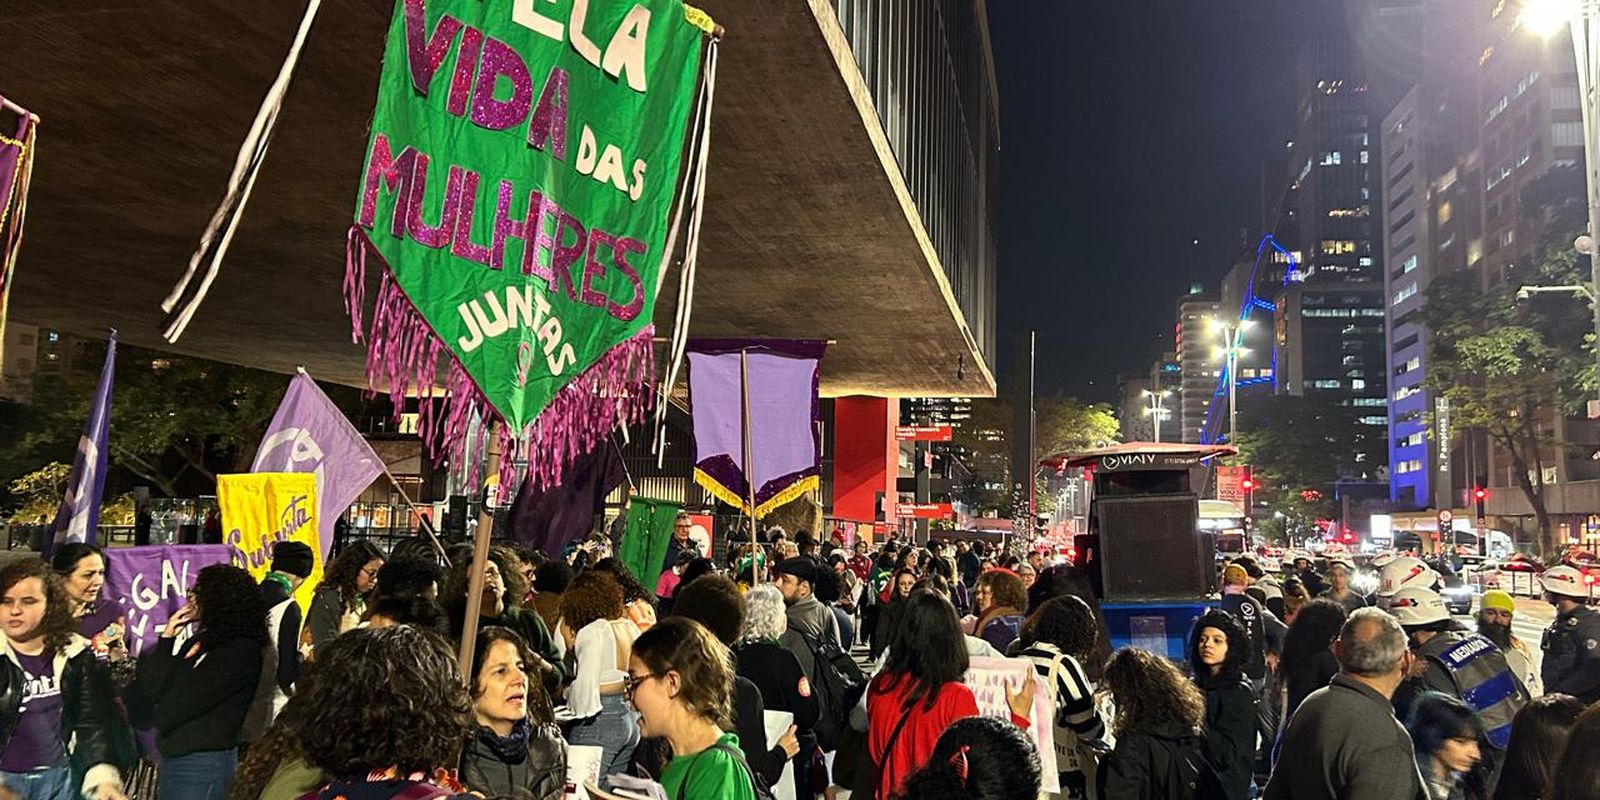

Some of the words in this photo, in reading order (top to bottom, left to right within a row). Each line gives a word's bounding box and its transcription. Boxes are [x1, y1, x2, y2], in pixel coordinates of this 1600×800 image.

[403, 0, 570, 162] VIDA
[576, 124, 647, 201] DAS
[359, 132, 648, 322] MULHERES
[457, 285, 577, 377] JUNTAS
